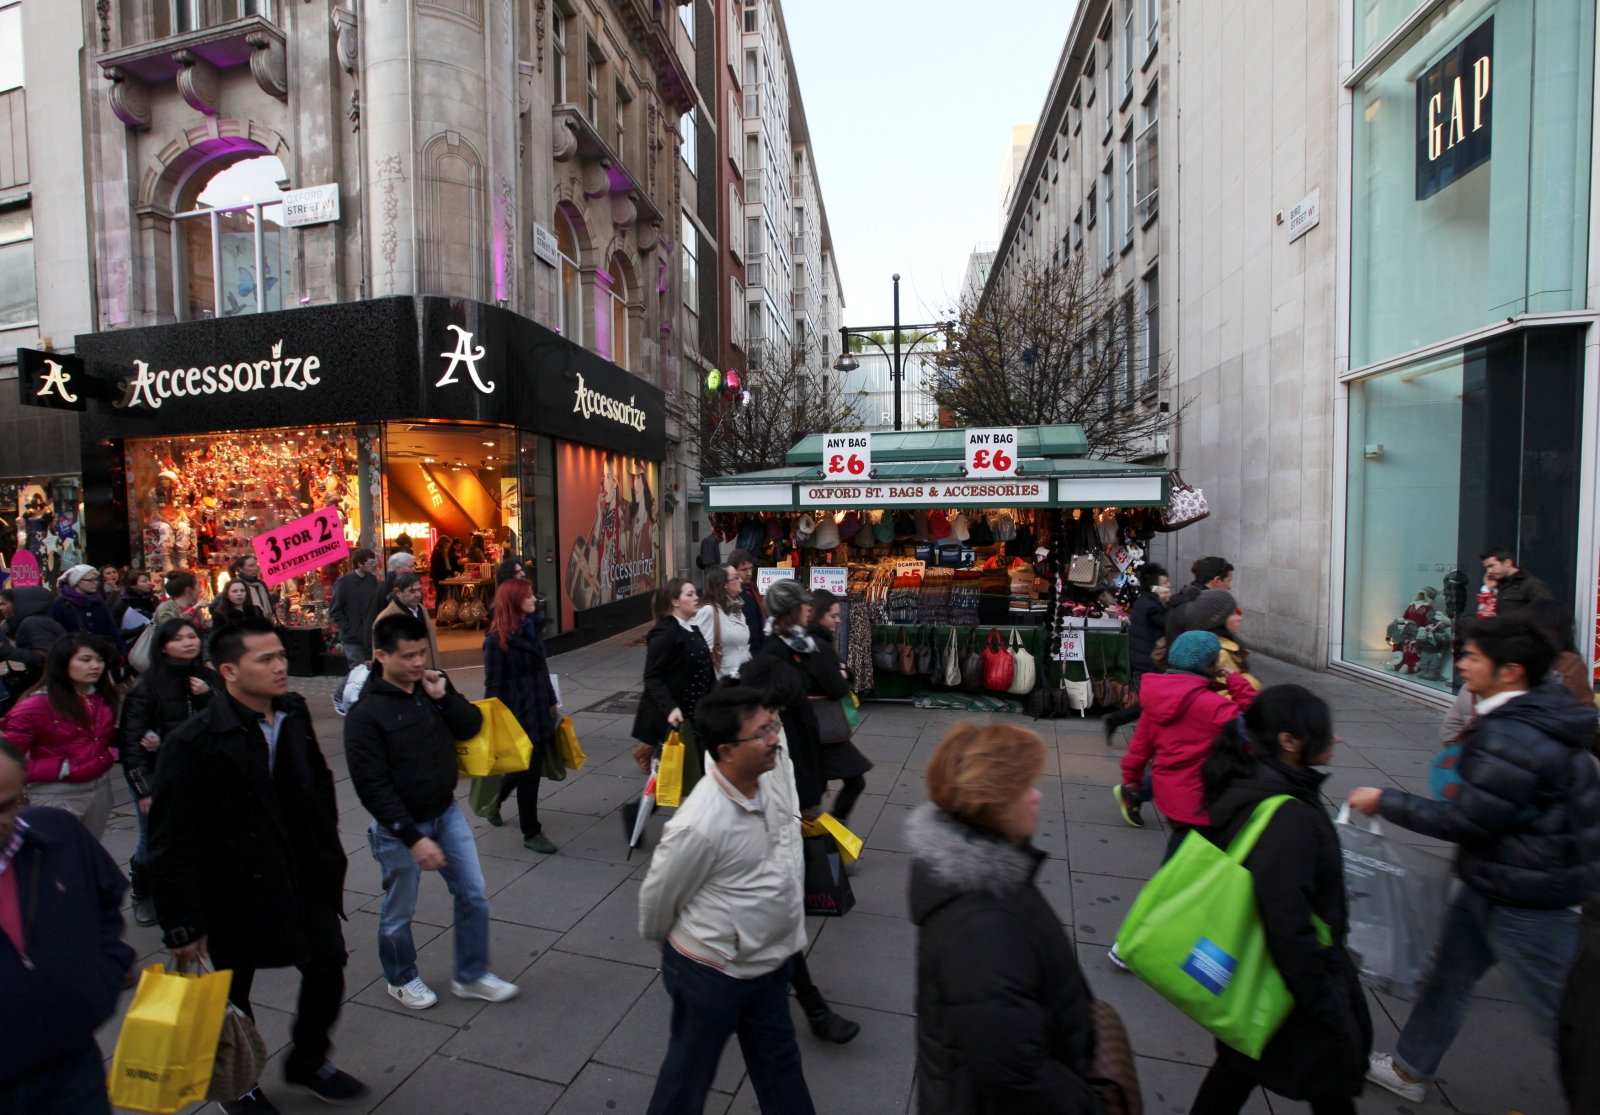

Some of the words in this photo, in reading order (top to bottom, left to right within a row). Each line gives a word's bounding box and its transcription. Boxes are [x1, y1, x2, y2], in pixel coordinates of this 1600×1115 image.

[1428, 56, 1490, 161] GAP
[286, 190, 323, 204] OXFORD
[287, 201, 320, 215] STREET
[322, 199, 335, 210] W1
[1290, 205, 1301, 220] BIRD
[1290, 211, 1307, 231] STREET
[1308, 205, 1315, 217] W1
[536, 236, 551, 252] STREET
[435, 324, 495, 394] A
[37, 359, 78, 402] A
[128, 339, 321, 408] Accessorize
[573, 372, 647, 432] Accessorize
[881, 411, 937, 423] RISS
[827, 438, 846, 448] ANY
[848, 437, 867, 448] BAG
[969, 434, 990, 444] ANY
[993, 434, 1013, 444] BAG
[828, 454, 865, 474] £6
[972, 449, 1012, 471] £6
[808, 487, 861, 499] OXFORD
[865, 487, 884, 498] ST.
[889, 486, 924, 498] BAGS
[928, 486, 939, 497] &
[943, 485, 1040, 497] ACCESSORIES
[384, 522, 430, 539] MORE
[266, 536, 282, 564] 3
[282, 529, 313, 551] FOR
[314, 516, 332, 543] 2
[267, 565, 280, 575] ON
[281, 541, 341, 570] EVERYTHING!
[601, 550, 653, 589] Accessorize
[813, 576, 826, 584] £5
[831, 585, 844, 593] £8
